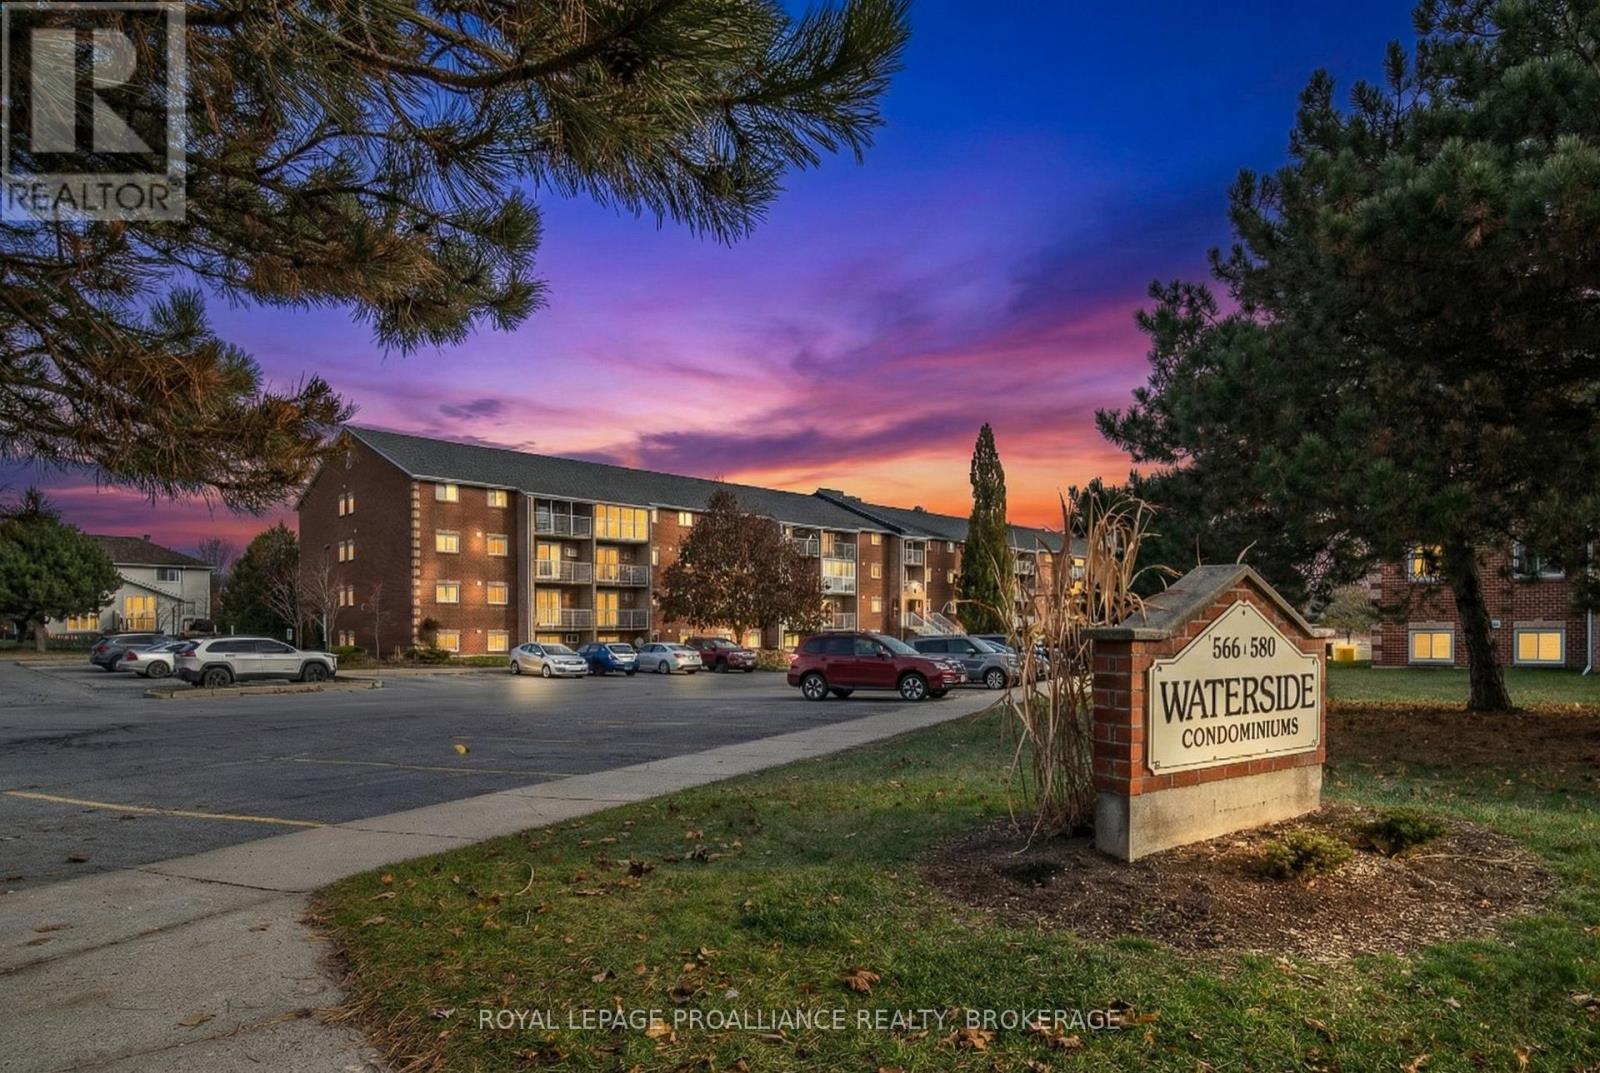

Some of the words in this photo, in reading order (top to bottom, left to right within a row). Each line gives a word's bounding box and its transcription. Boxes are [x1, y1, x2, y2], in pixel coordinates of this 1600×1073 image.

[1213, 636, 1241, 659] 566
[1250, 636, 1276, 658] 580
[1160, 673, 1315, 724] WATERSIDE
[1182, 716, 1299, 749] CONDOMINIUMS
